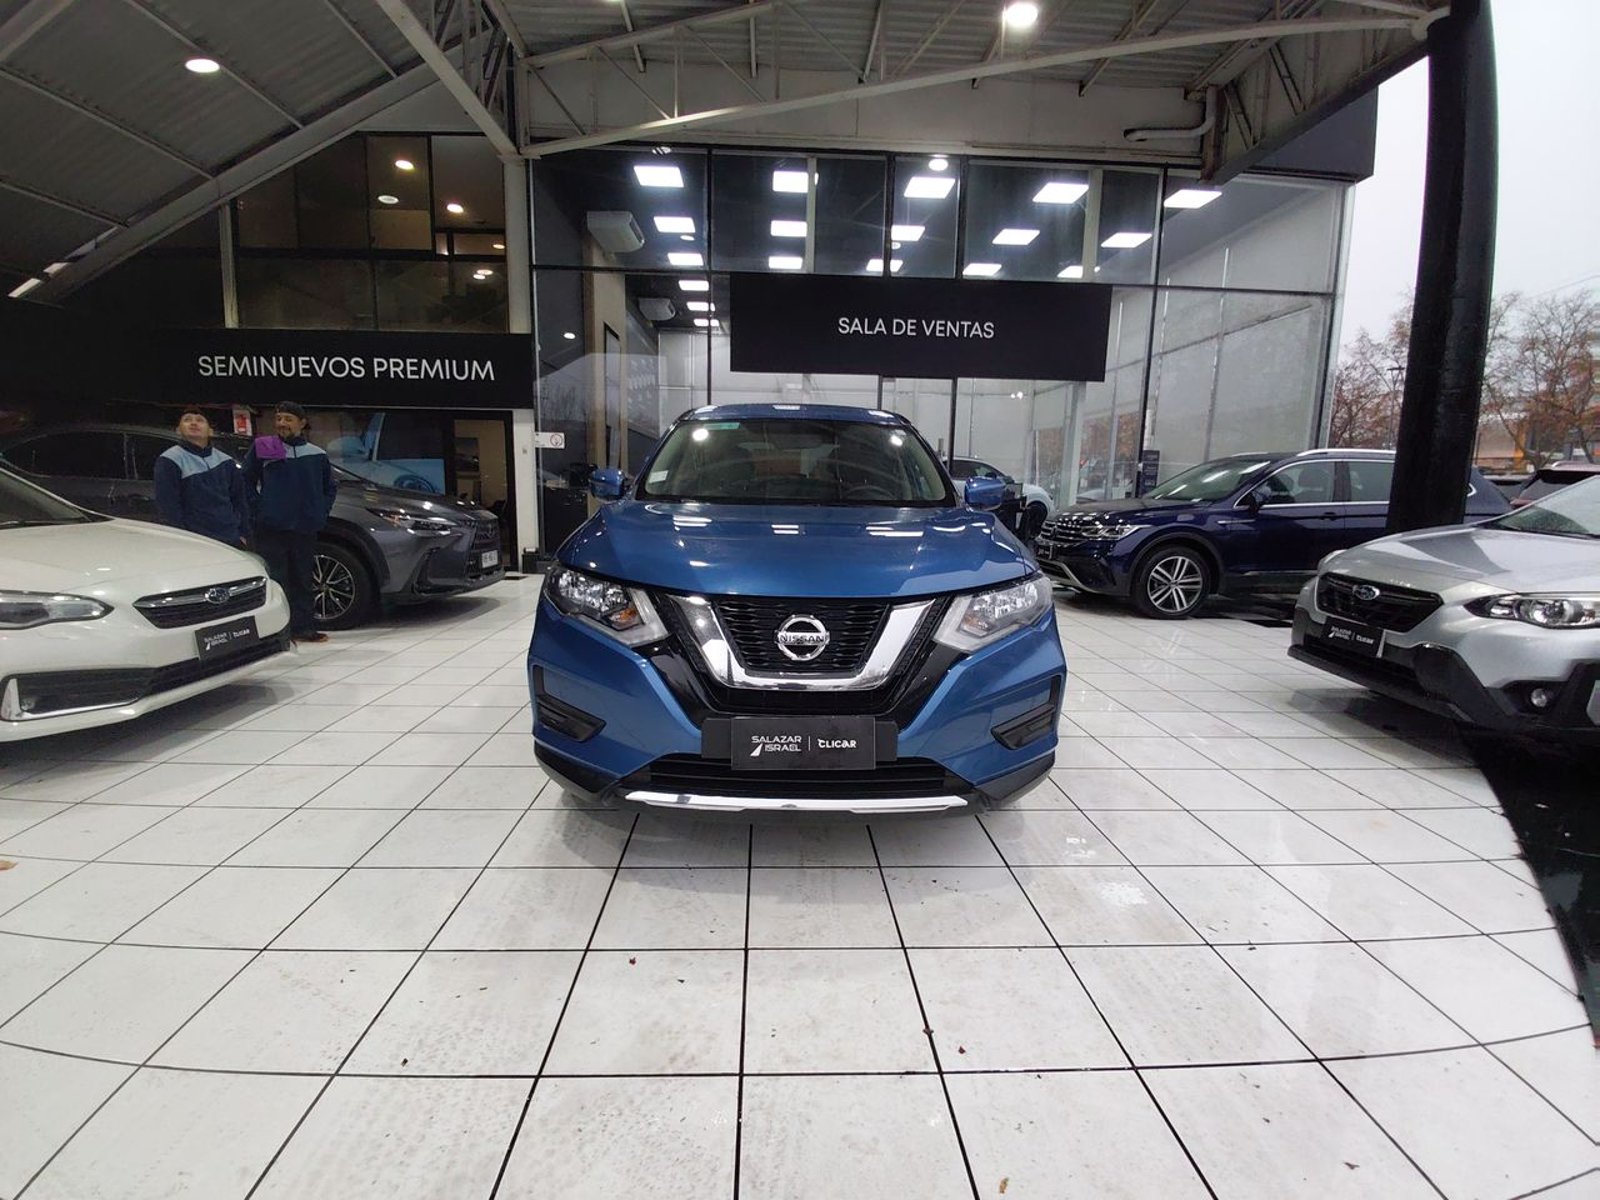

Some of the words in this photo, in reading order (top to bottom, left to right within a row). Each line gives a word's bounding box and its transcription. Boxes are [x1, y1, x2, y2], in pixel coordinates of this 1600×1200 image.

[838, 317, 887, 335] SALA
[892, 318, 917, 336] DE
[922, 320, 995, 339] VENTAS
[198, 355, 366, 378] SEMINUEVOS
[373, 357, 495, 381] PREMIUM
[779, 633, 825, 643] NISSAN
[751, 735, 802, 743] SALAZAR
[817, 738, 857, 749] CLICAR
[764, 743, 802, 752] ISRAEL
